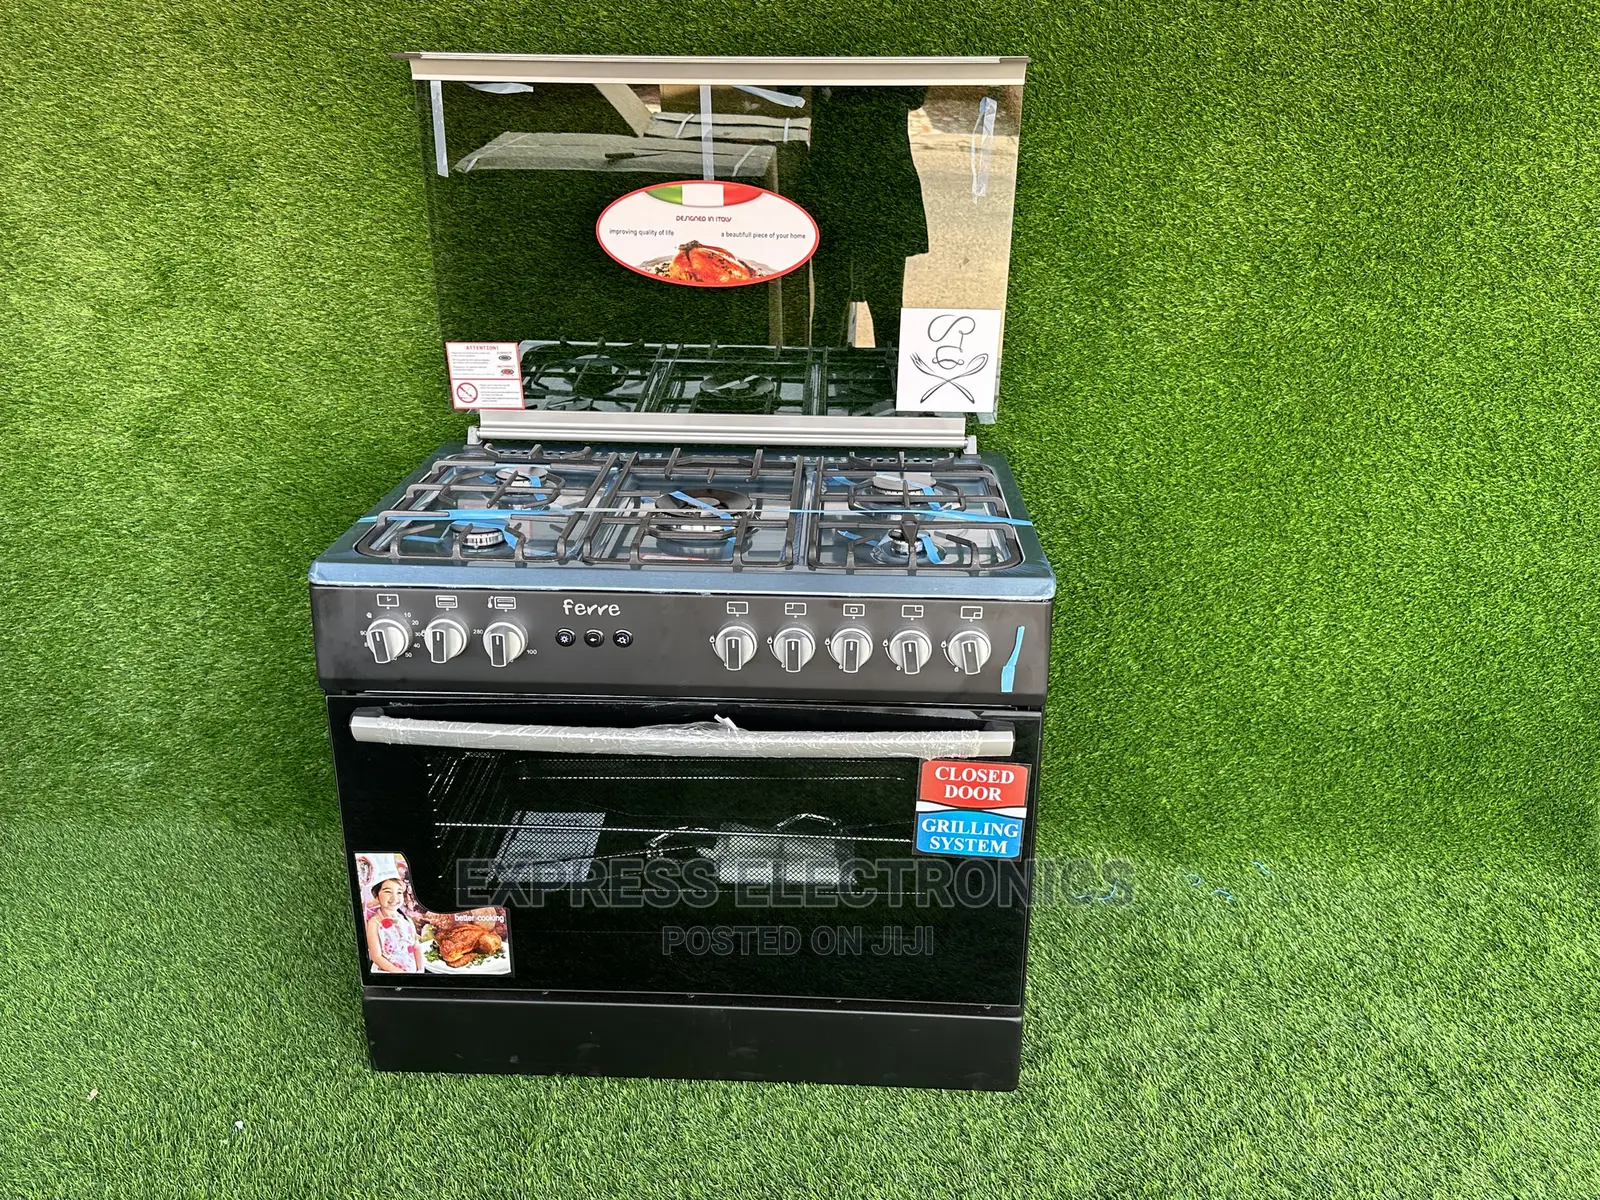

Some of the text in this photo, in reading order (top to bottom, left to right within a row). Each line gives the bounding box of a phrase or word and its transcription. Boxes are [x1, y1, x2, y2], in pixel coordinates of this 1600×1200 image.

[609, 228, 637, 236] improving
[638, 229, 657, 237] quality
[752, 231, 768, 239] piece
[768, 231, 775, 239] of
[562, 598, 621, 616] ferre
[935, 766, 1015, 784] CLOSED
[944, 784, 1002, 801] DOOR
[921, 818, 1019, 838] GRILLING
[929, 836, 1008, 854] SYSTEM
[454, 914, 505, 923] better cooking
